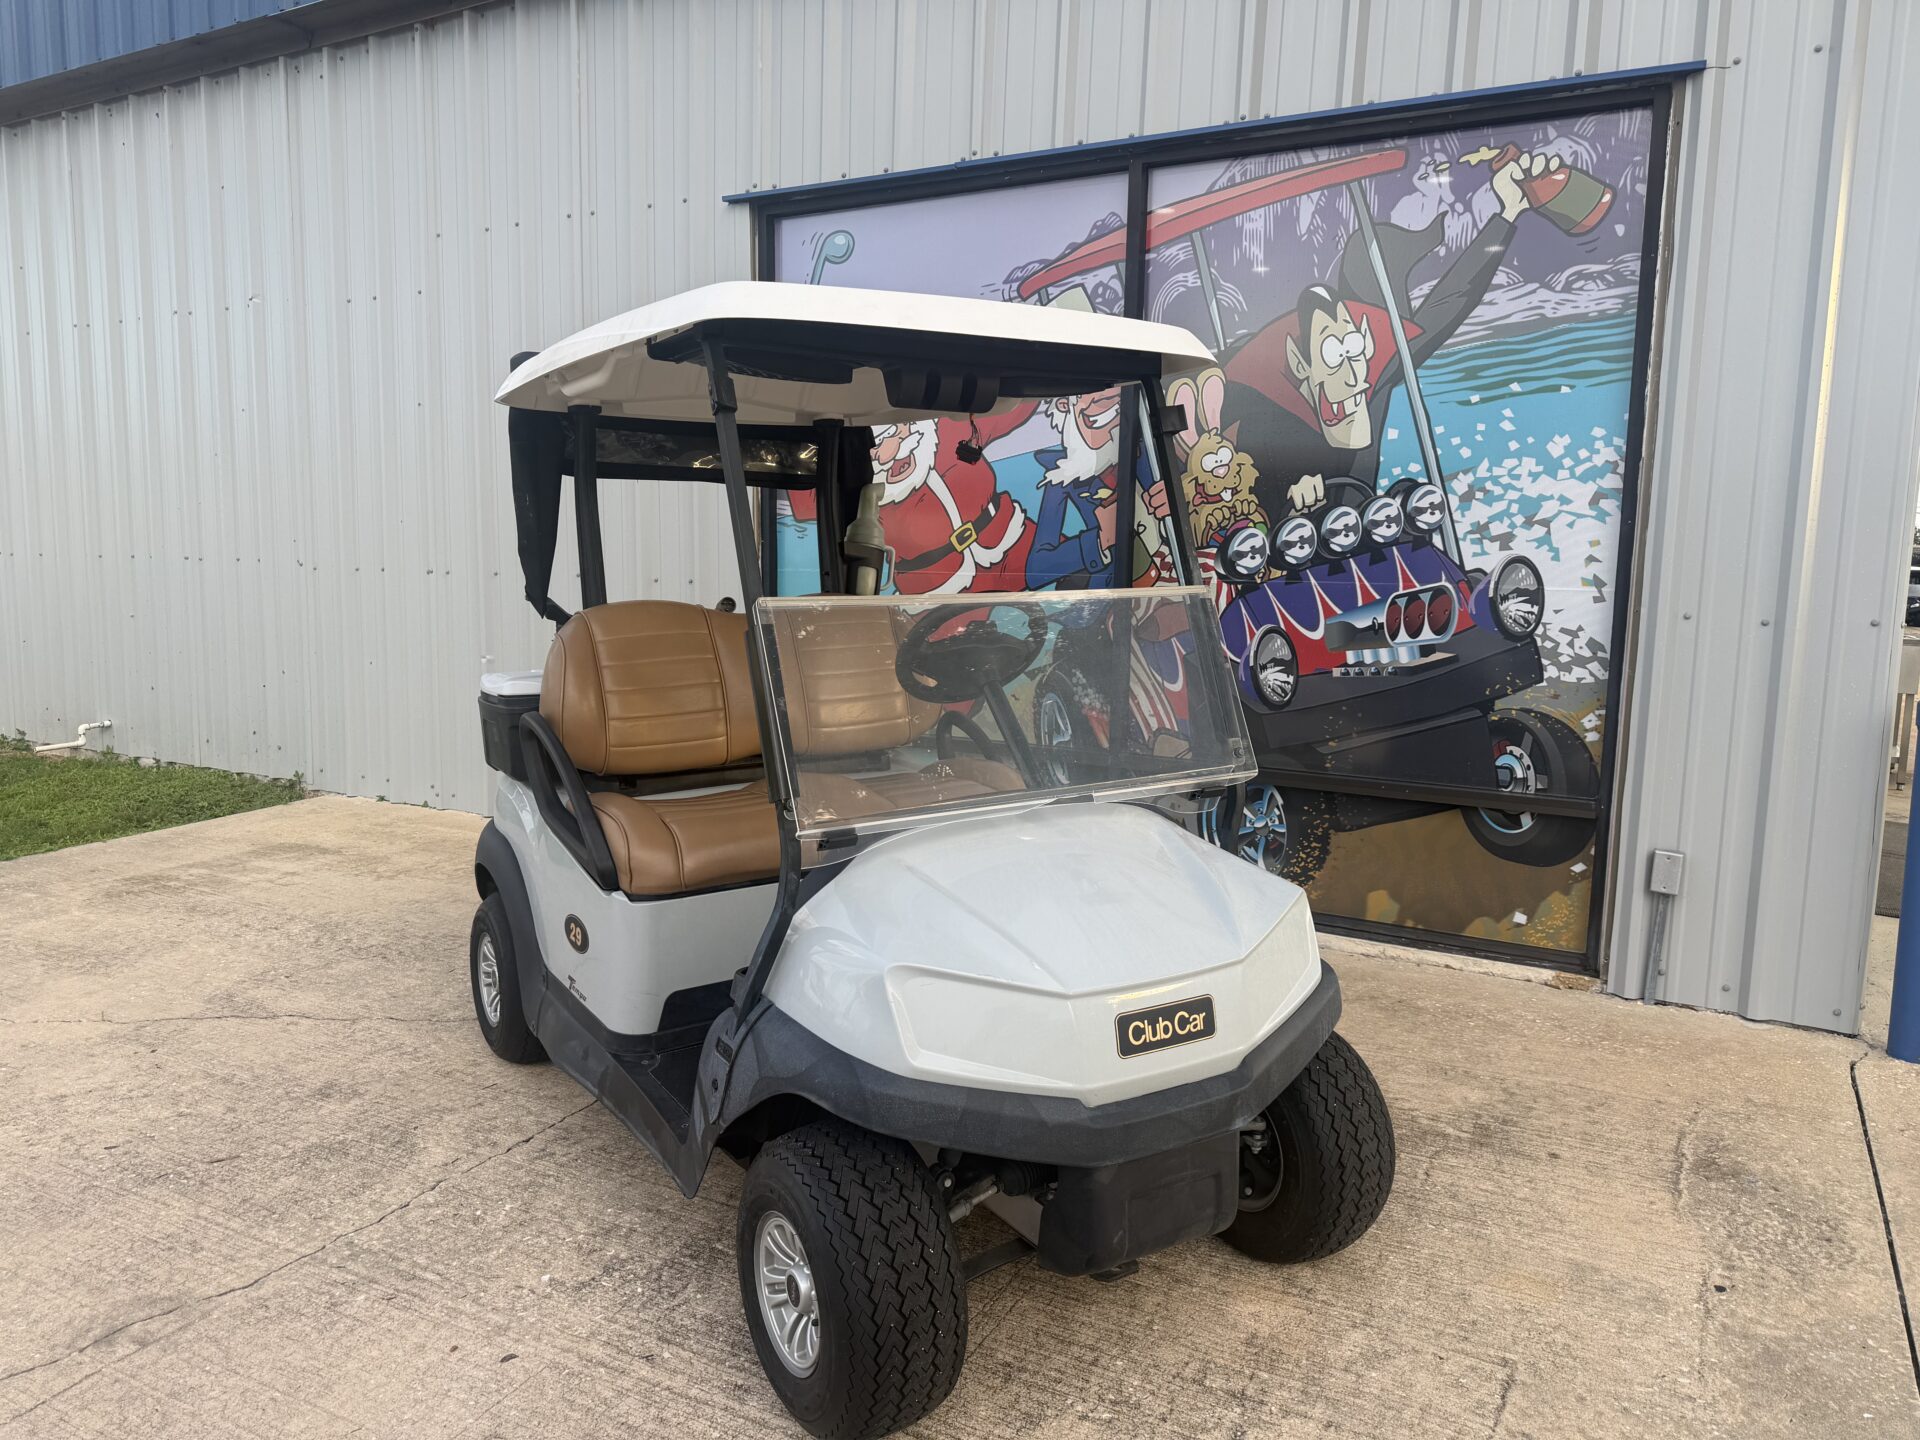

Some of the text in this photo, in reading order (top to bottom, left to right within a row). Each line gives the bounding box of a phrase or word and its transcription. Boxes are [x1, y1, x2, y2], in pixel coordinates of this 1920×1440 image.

[569, 922, 582, 946] 29
[567, 974, 587, 1002] Tempo
[1128, 1010, 1205, 1045] Club Car
